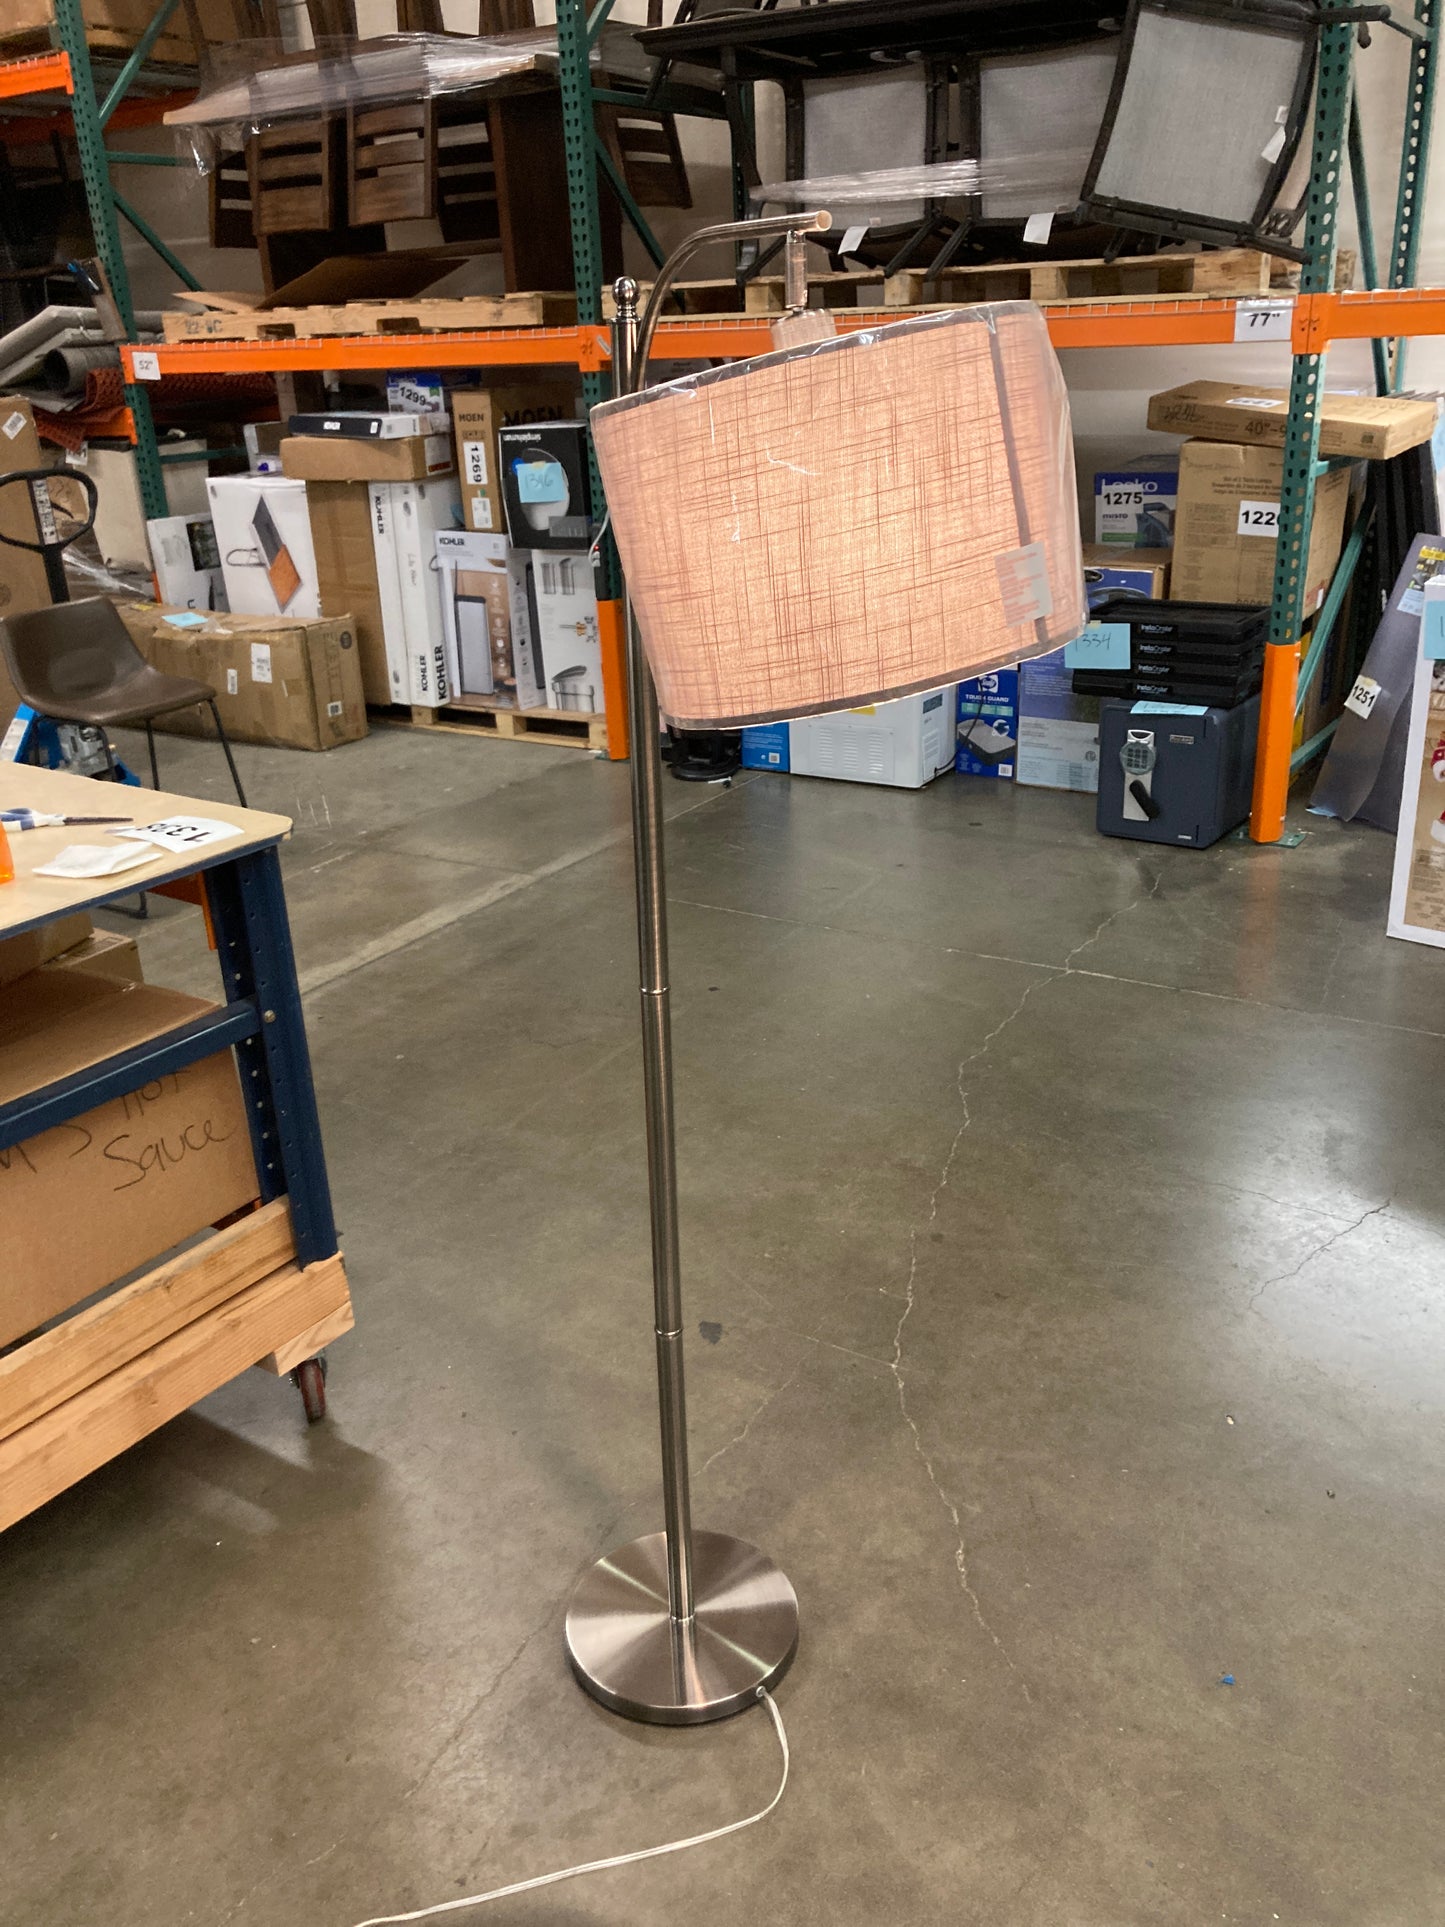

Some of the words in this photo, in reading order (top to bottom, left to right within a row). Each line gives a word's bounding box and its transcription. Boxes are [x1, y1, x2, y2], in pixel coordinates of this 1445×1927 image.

[1248, 312, 1281, 328] 77"
[399, 386, 427, 406] 1299
[458, 413, 485, 423] MOEN
[470, 444, 483, 483] 1269
[1103, 492, 1143, 505] 1275
[375, 495, 385, 535] KOHLER
[1241, 510, 1280, 526] 122
[439, 537, 465, 546] KOHLER
[1075, 632, 1112, 653] 1334
[419, 655, 428, 692] KOHLER
[434, 643, 448, 701] KOHLER
[987, 695, 1009, 703] GUARD
[1352, 684, 1376, 707] 1251
[103, 1119, 238, 1192] Sauce
